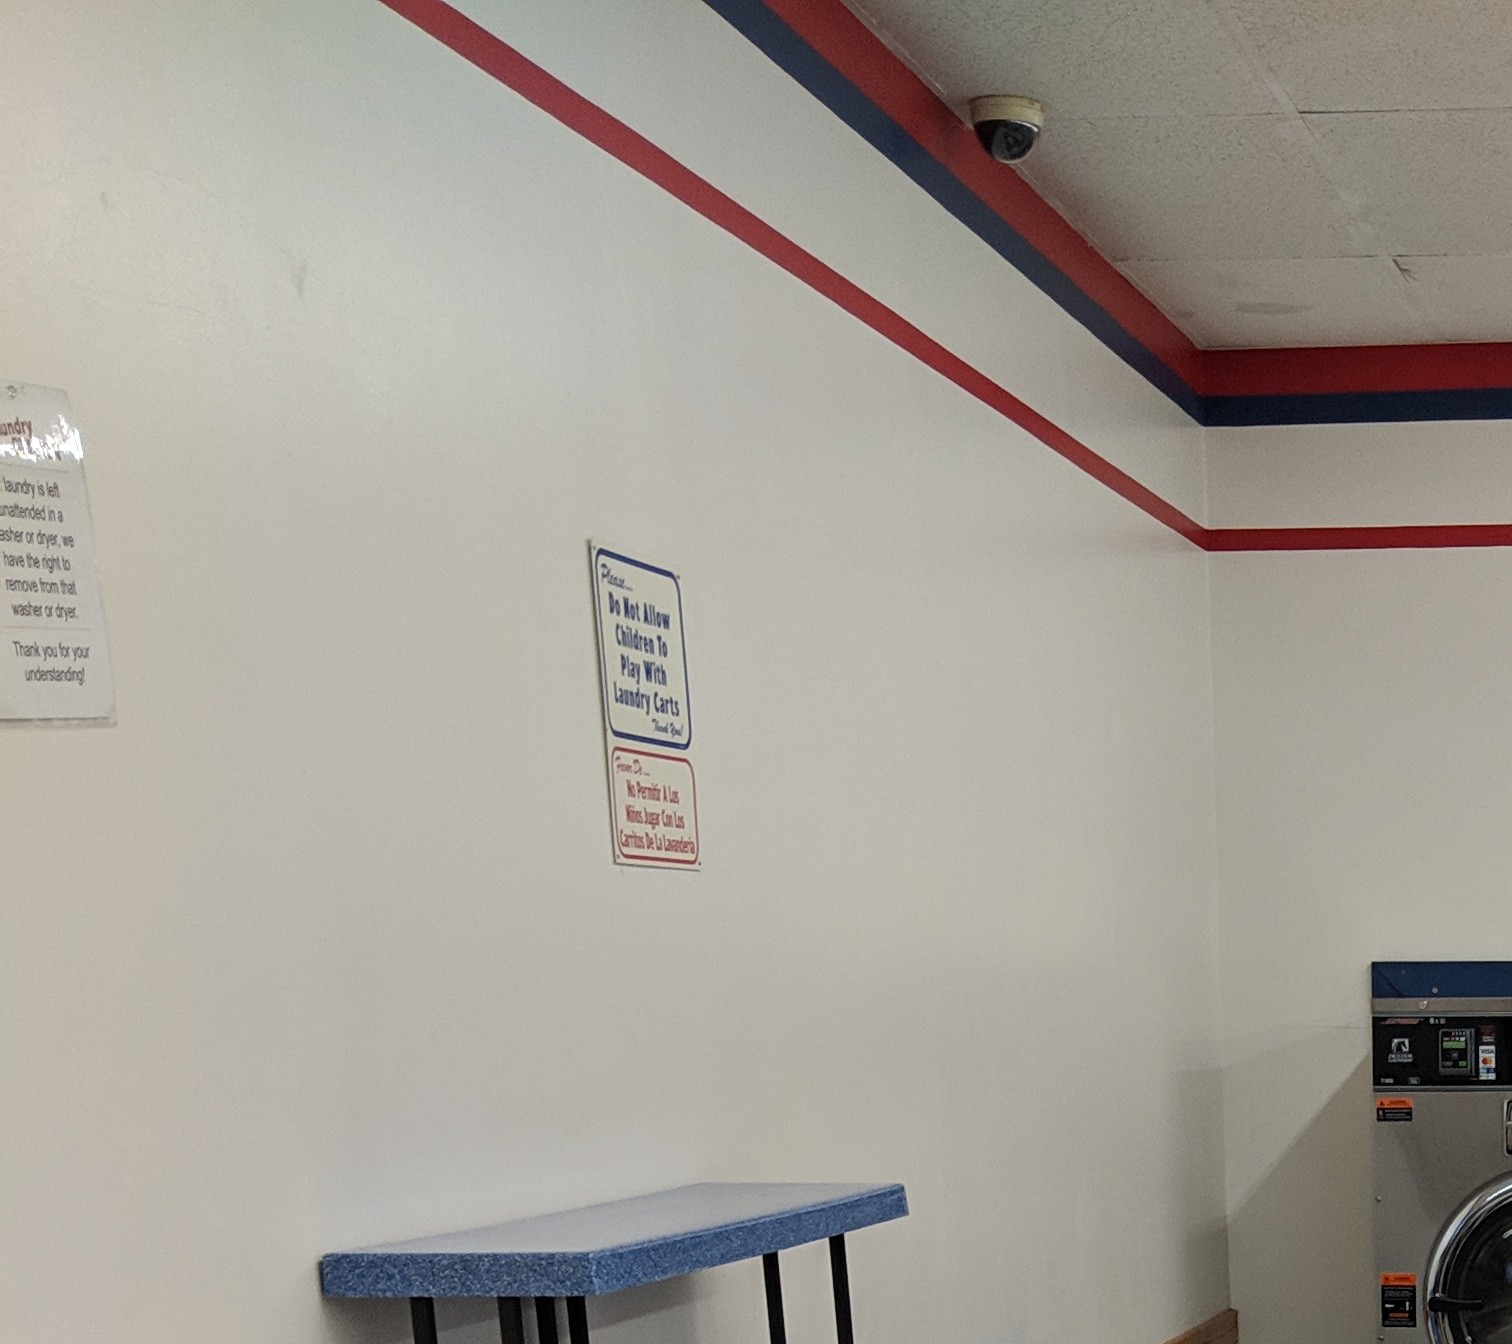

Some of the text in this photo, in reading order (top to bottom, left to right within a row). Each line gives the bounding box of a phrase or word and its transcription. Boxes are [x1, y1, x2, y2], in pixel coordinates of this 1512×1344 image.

[3, 476, 61, 499] laundry is left
[47, 507, 56, 520] in
[57, 510, 64, 522] a
[26, 531, 35, 544] or
[37, 529, 61, 549] dryer,
[62, 535, 75, 548] we
[3, 551, 72, 573] have the right to
[6, 578, 78, 595] remove from that
[11, 602, 80, 622] washer or dryer.
[608, 591, 671, 630] Do Not Allow
[615, 623, 669, 658] Children To
[13, 641, 91, 661] Thank you for your
[25, 666, 86, 686] understanding!
[620, 653, 668, 686] Play With
[613, 681, 680, 717] Laundry Carts
[626, 779, 636, 798] No
